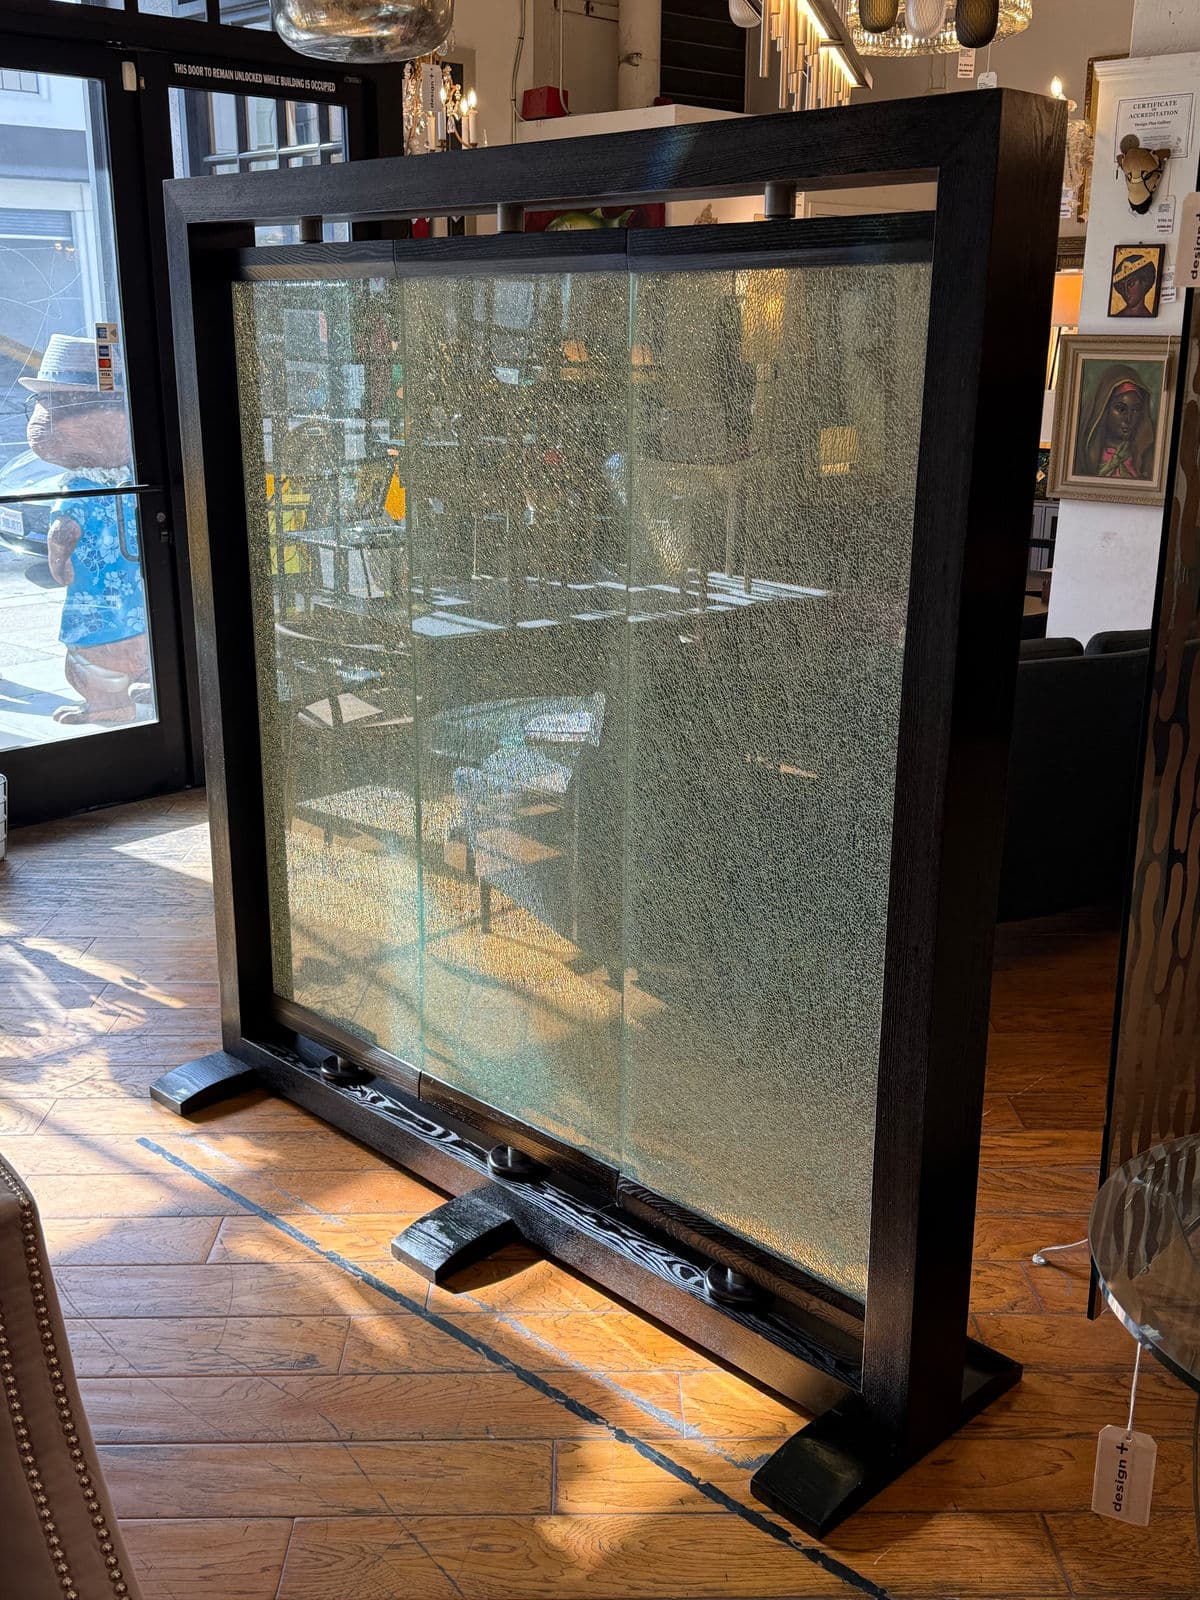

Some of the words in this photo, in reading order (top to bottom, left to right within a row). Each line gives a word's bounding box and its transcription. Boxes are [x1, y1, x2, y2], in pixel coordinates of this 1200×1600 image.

[174, 63, 187, 74] THIS
[188, 65, 204, 76] DOOR
[204, 67, 212, 77] TO
[213, 68, 233, 80] REMAIN
[235, 71, 263, 83] UNLOCKED
[263, 74, 280, 85] WHILE
[281, 77, 304, 88] BUILDING
[305, 80, 311, 89] IS
[311, 81, 336, 92] OCCUPIED
[1133, 100, 1178, 109] CERTIFICATE
[1129, 110, 1178, 119] ACCREDITATION
[1112, 1459, 1128, 1512] design
